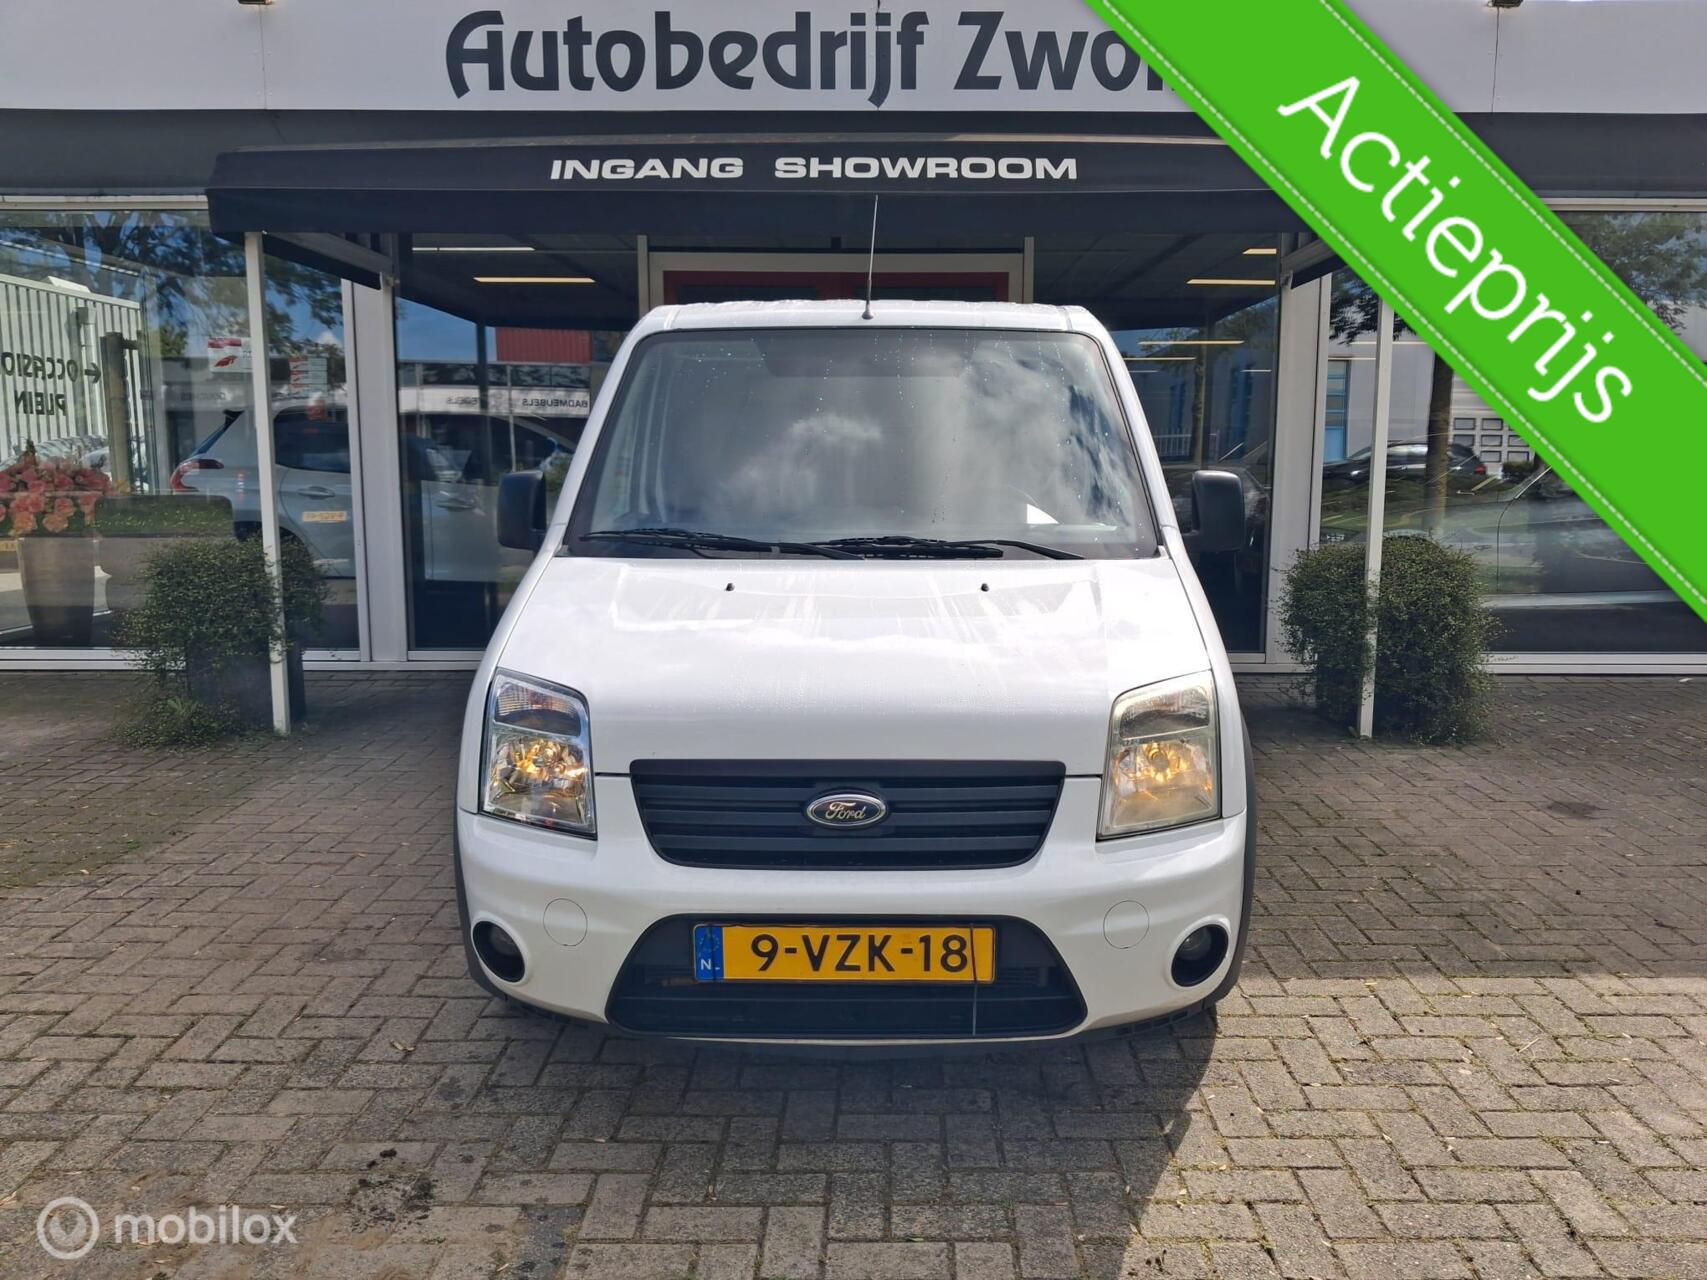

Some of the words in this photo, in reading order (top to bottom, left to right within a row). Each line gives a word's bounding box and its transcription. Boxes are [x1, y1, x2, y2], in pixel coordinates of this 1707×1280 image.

[446, 10, 930, 108] Autobedrijf
[953, 11, 1176, 92] Zwo
[550, 157, 744, 180] INGANG
[774, 156, 1078, 180] SHOWROOM
[825, 801, 868, 820] Ford
[750, 933, 969, 974] 9-VZK-18
